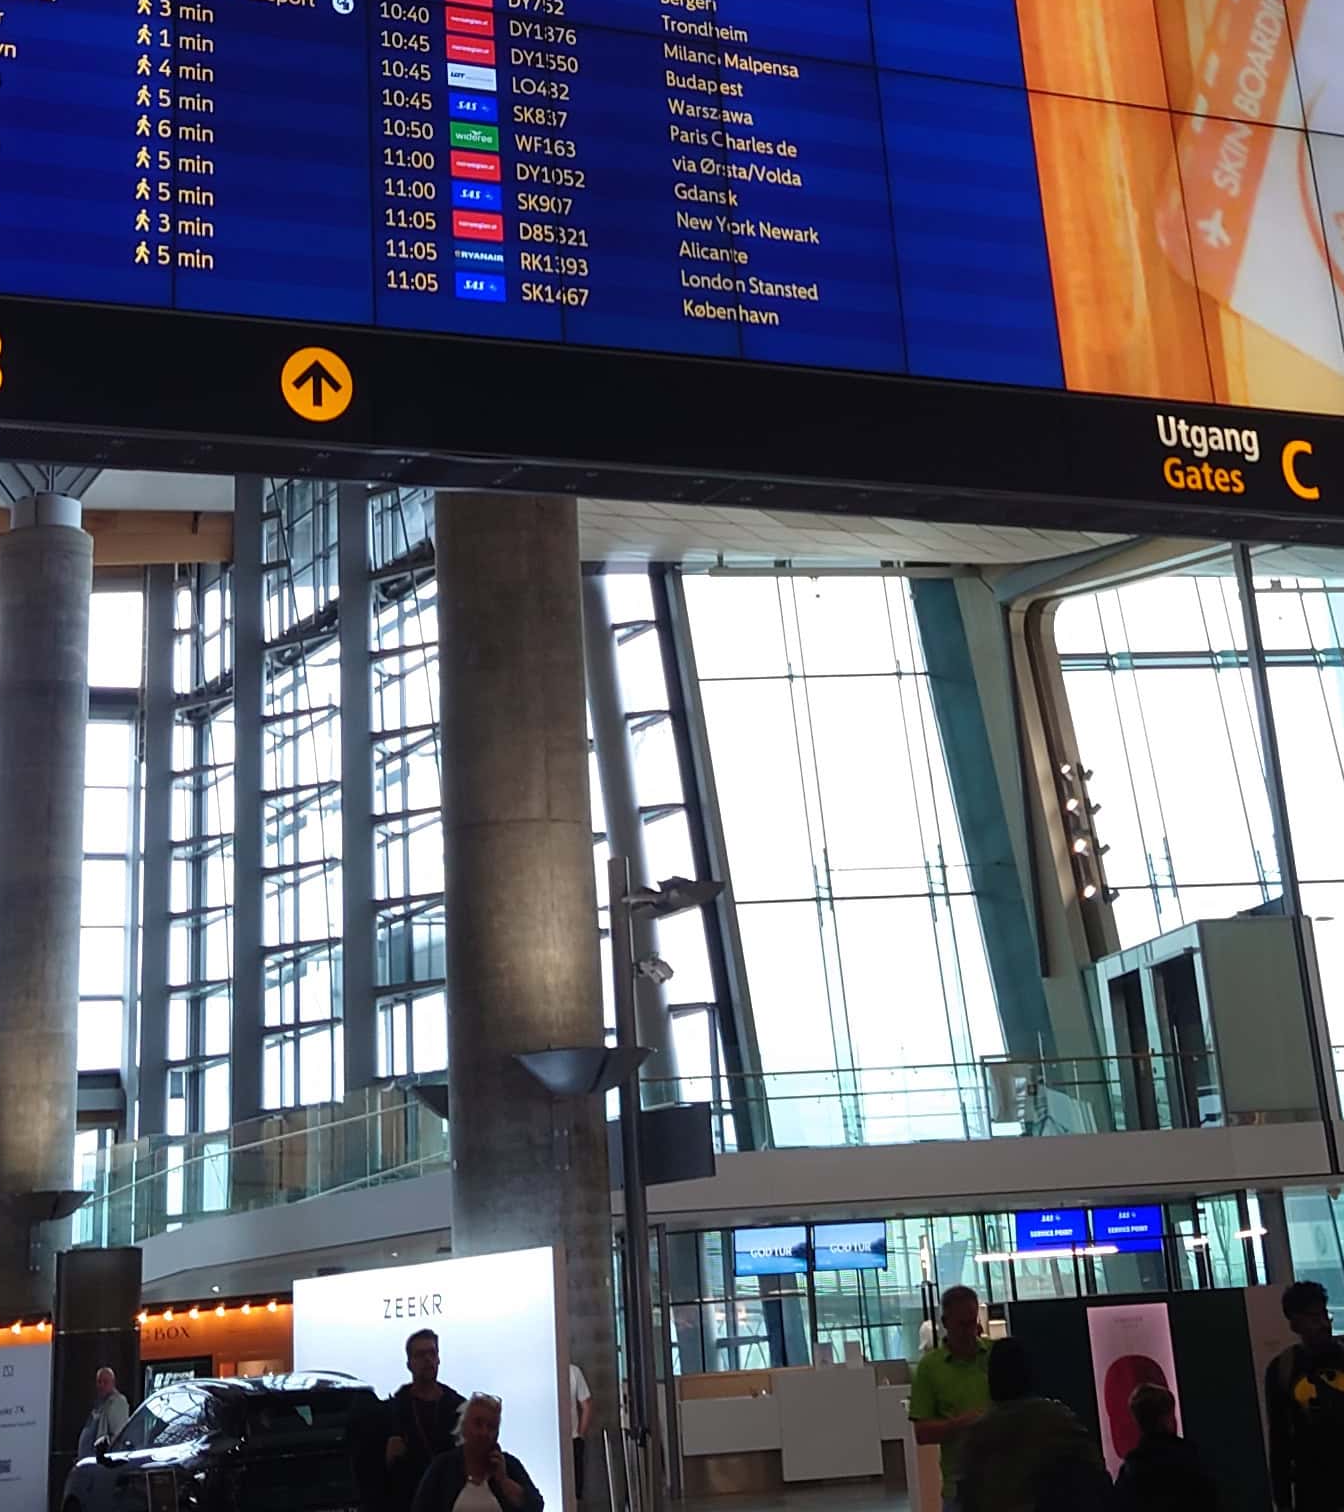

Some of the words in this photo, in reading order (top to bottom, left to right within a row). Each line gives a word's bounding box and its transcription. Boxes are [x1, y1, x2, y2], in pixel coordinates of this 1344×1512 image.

[383, 118, 434, 140] 10:50
[514, 134, 576, 158] WF163
[671, 155, 697, 173] via
[700, 158, 803, 187] Ørsta/Volda
[1212, 121, 1253, 198] SKIN
[387, 269, 439, 292] 11:05
[521, 282, 589, 307] SK1467
[683, 299, 779, 326] København
[460, 250, 504, 263] RYANAIR
[681, 269, 746, 293] London
[748, 276, 819, 301] Stansted
[1156, 414, 1260, 462] Utgang
[1163, 456, 1246, 494] Gates
[1281, 439, 1320, 500] C
[383, 1294, 442, 1319] ZEEKR
